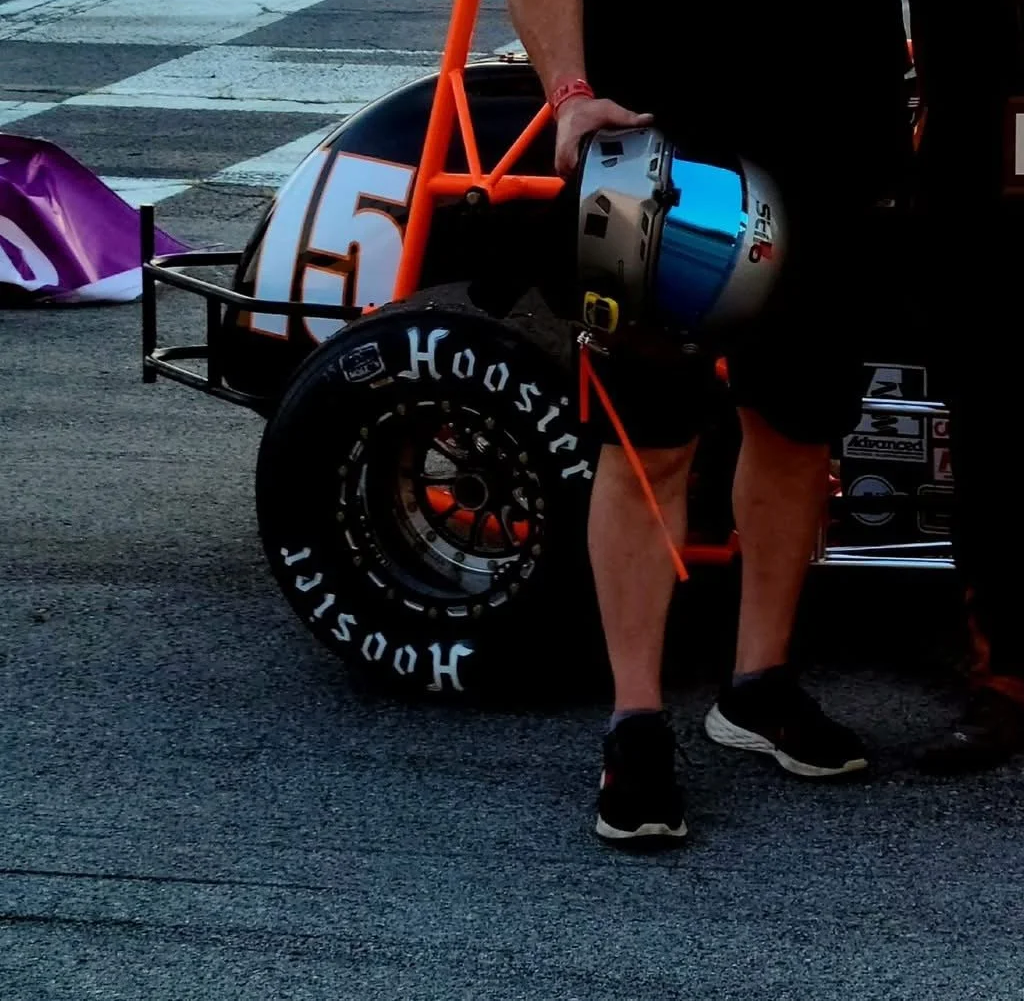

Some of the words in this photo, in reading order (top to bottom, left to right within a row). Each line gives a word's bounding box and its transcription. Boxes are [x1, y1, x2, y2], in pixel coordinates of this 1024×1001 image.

[242, 148, 418, 345] 15
[398, 326, 593, 481] Hoosier
[847, 434, 923, 451] Advanced
